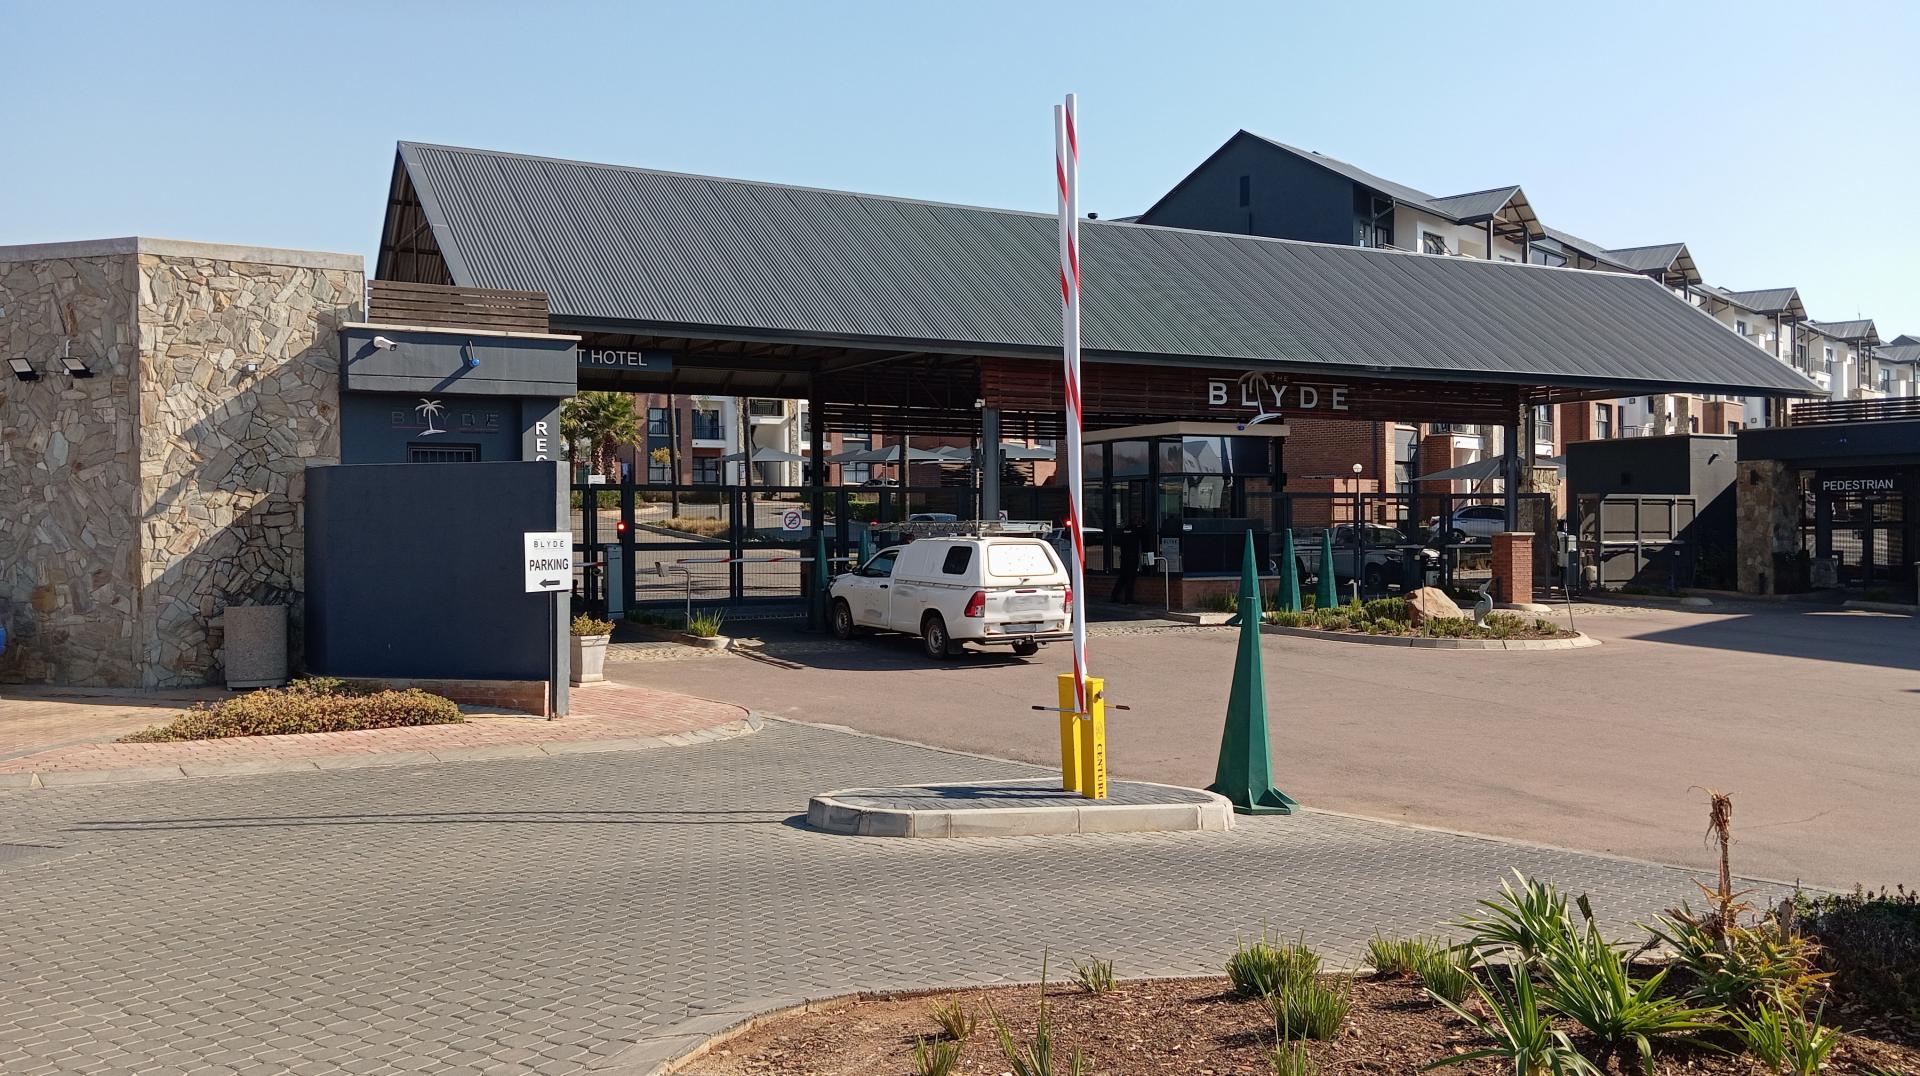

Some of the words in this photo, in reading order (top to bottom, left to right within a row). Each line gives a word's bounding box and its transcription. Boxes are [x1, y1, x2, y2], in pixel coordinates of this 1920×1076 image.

[591, 349, 648, 366] HOTEL
[1208, 381, 1349, 411] BLYDE
[391, 411, 500, 428] BLYDE
[1823, 479, 1894, 491] PEDESTRIAN
[533, 540, 564, 548] BLYDE
[529, 558, 569, 571] PARKING
